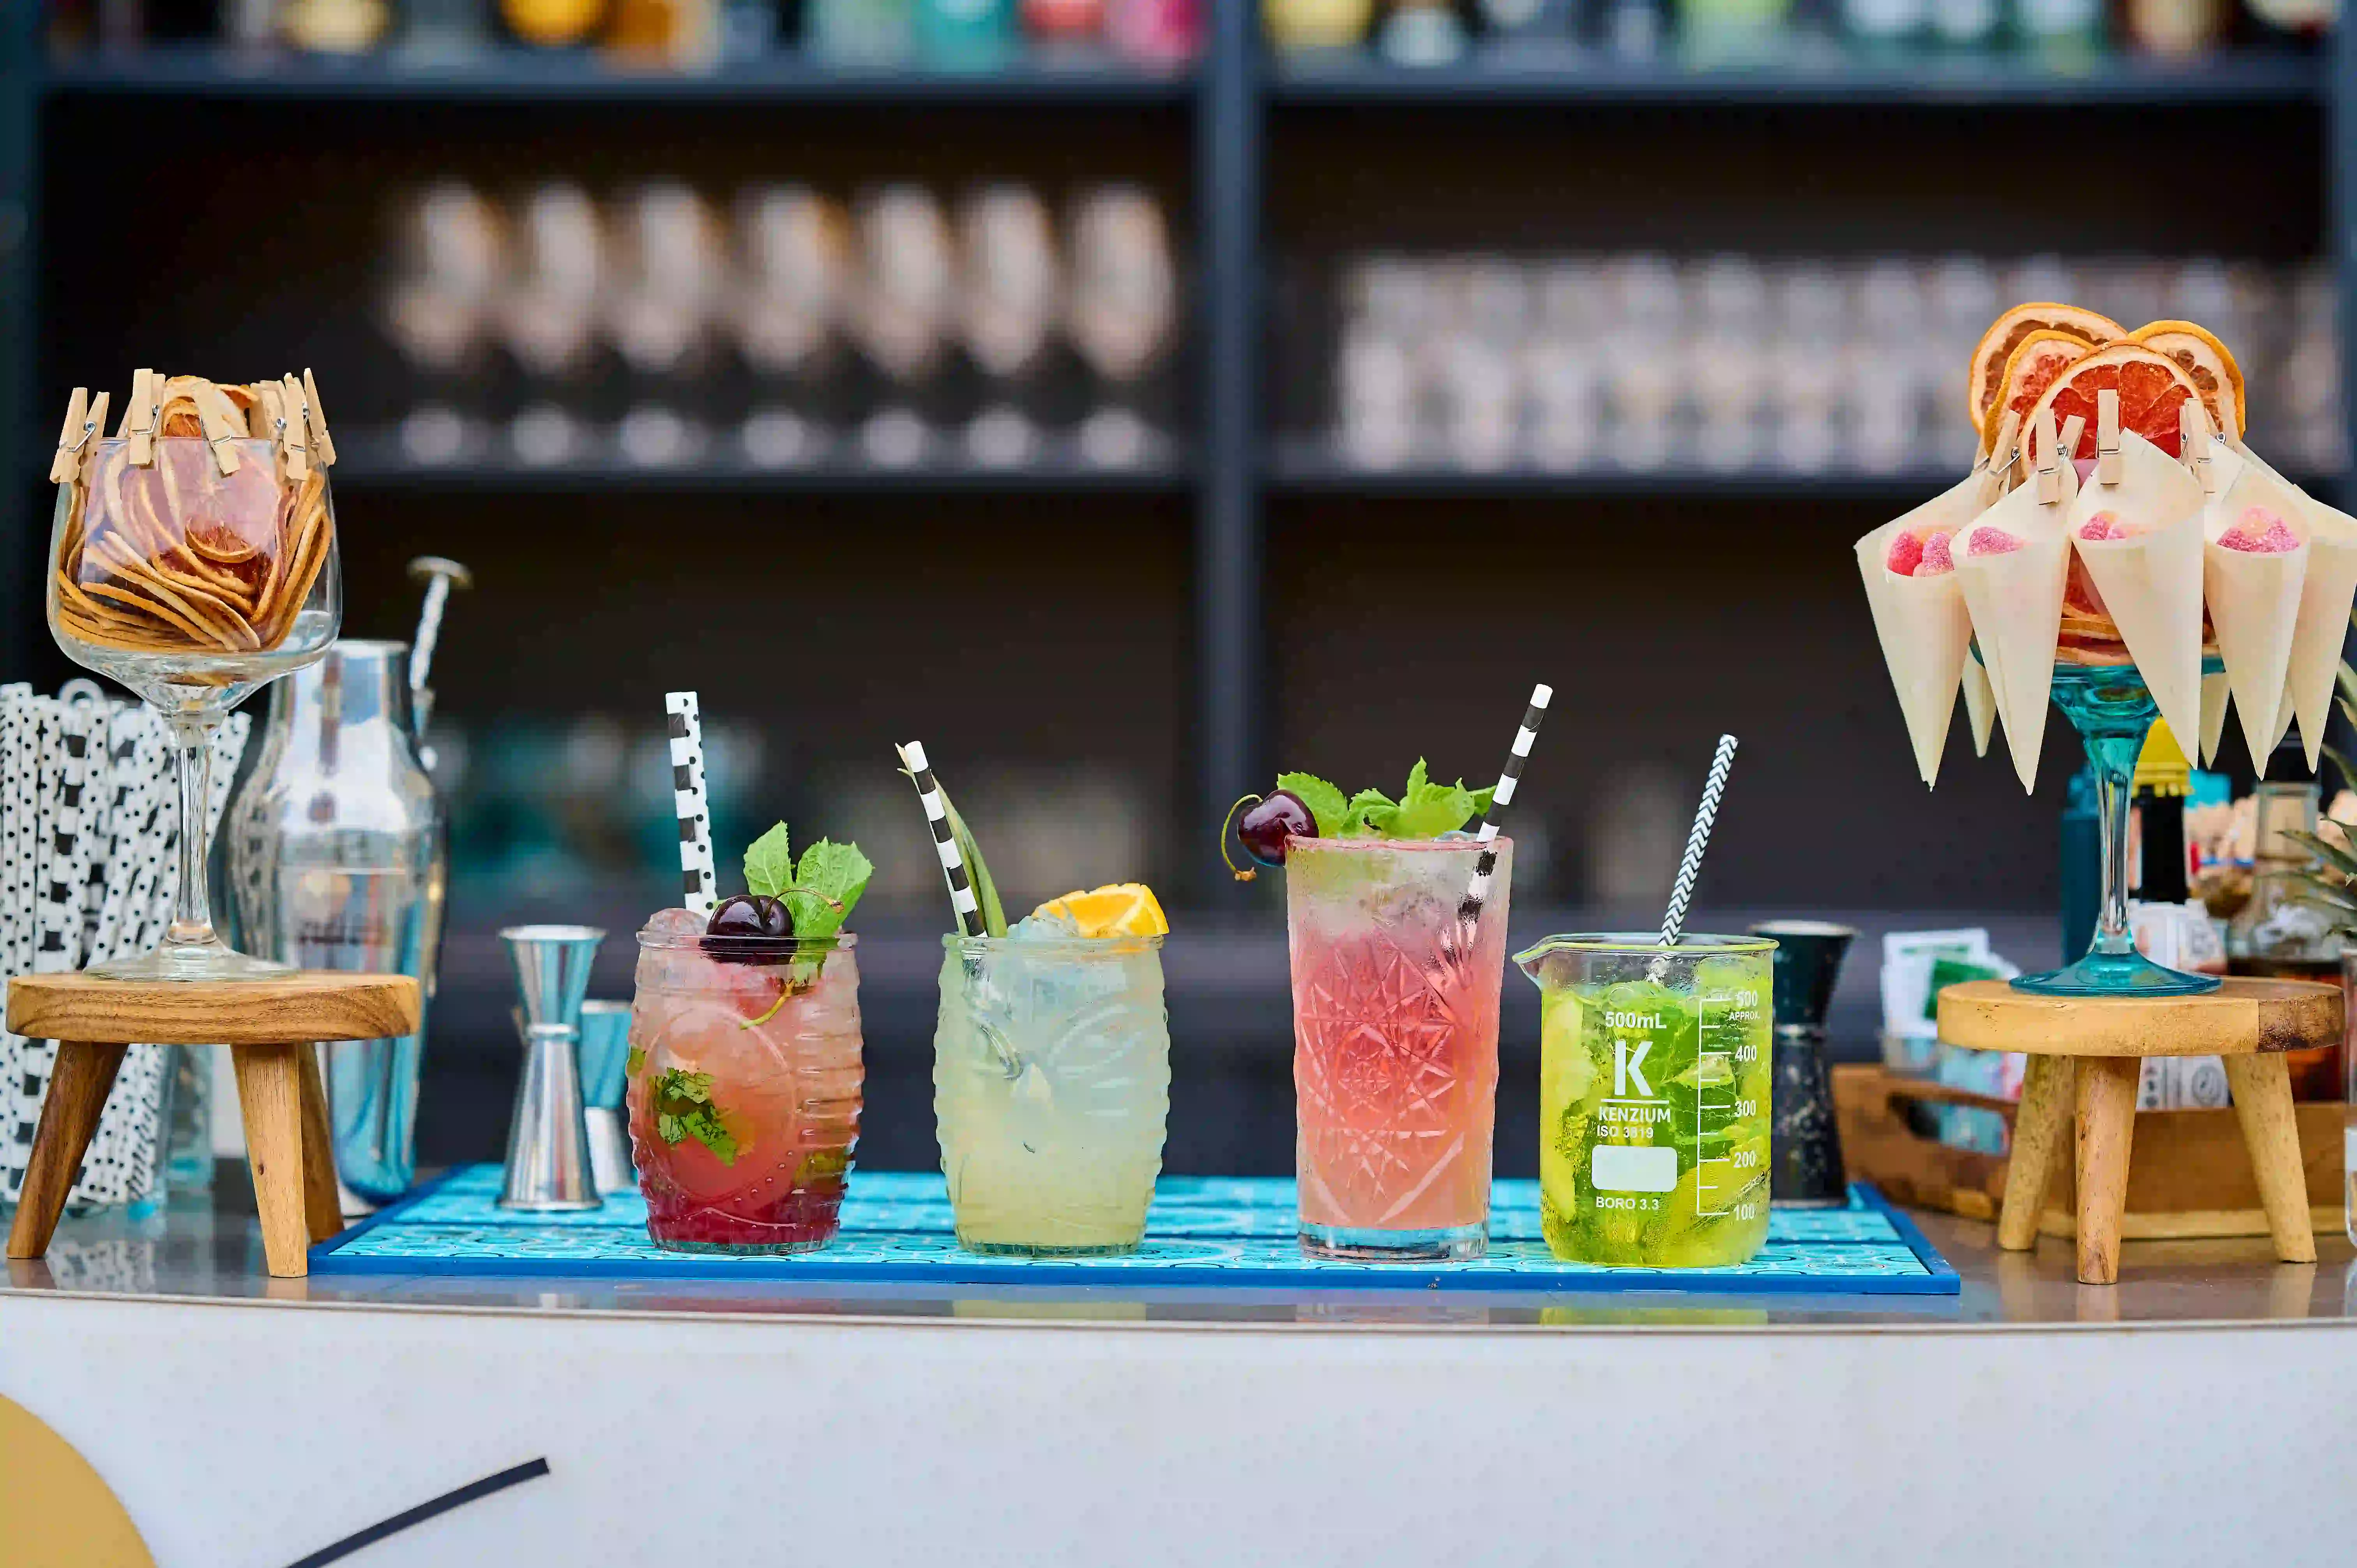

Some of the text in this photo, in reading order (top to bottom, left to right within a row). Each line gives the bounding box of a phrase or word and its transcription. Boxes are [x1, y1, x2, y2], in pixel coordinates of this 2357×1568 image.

[1605, 1011, 1667, 1029] 500mL
[1735, 1045, 1757, 1062] 400
[1614, 1039, 1654, 1096] K
[1599, 1106, 1671, 1123] KENZIUM
[1735, 1100, 1756, 1118] 300
[1597, 1125, 1618, 1137] ISO
[1733, 1151, 1756, 1168] 200
[1596, 1196, 1659, 1210] BORO 3.3
[1733, 1203, 1755, 1220] 100
